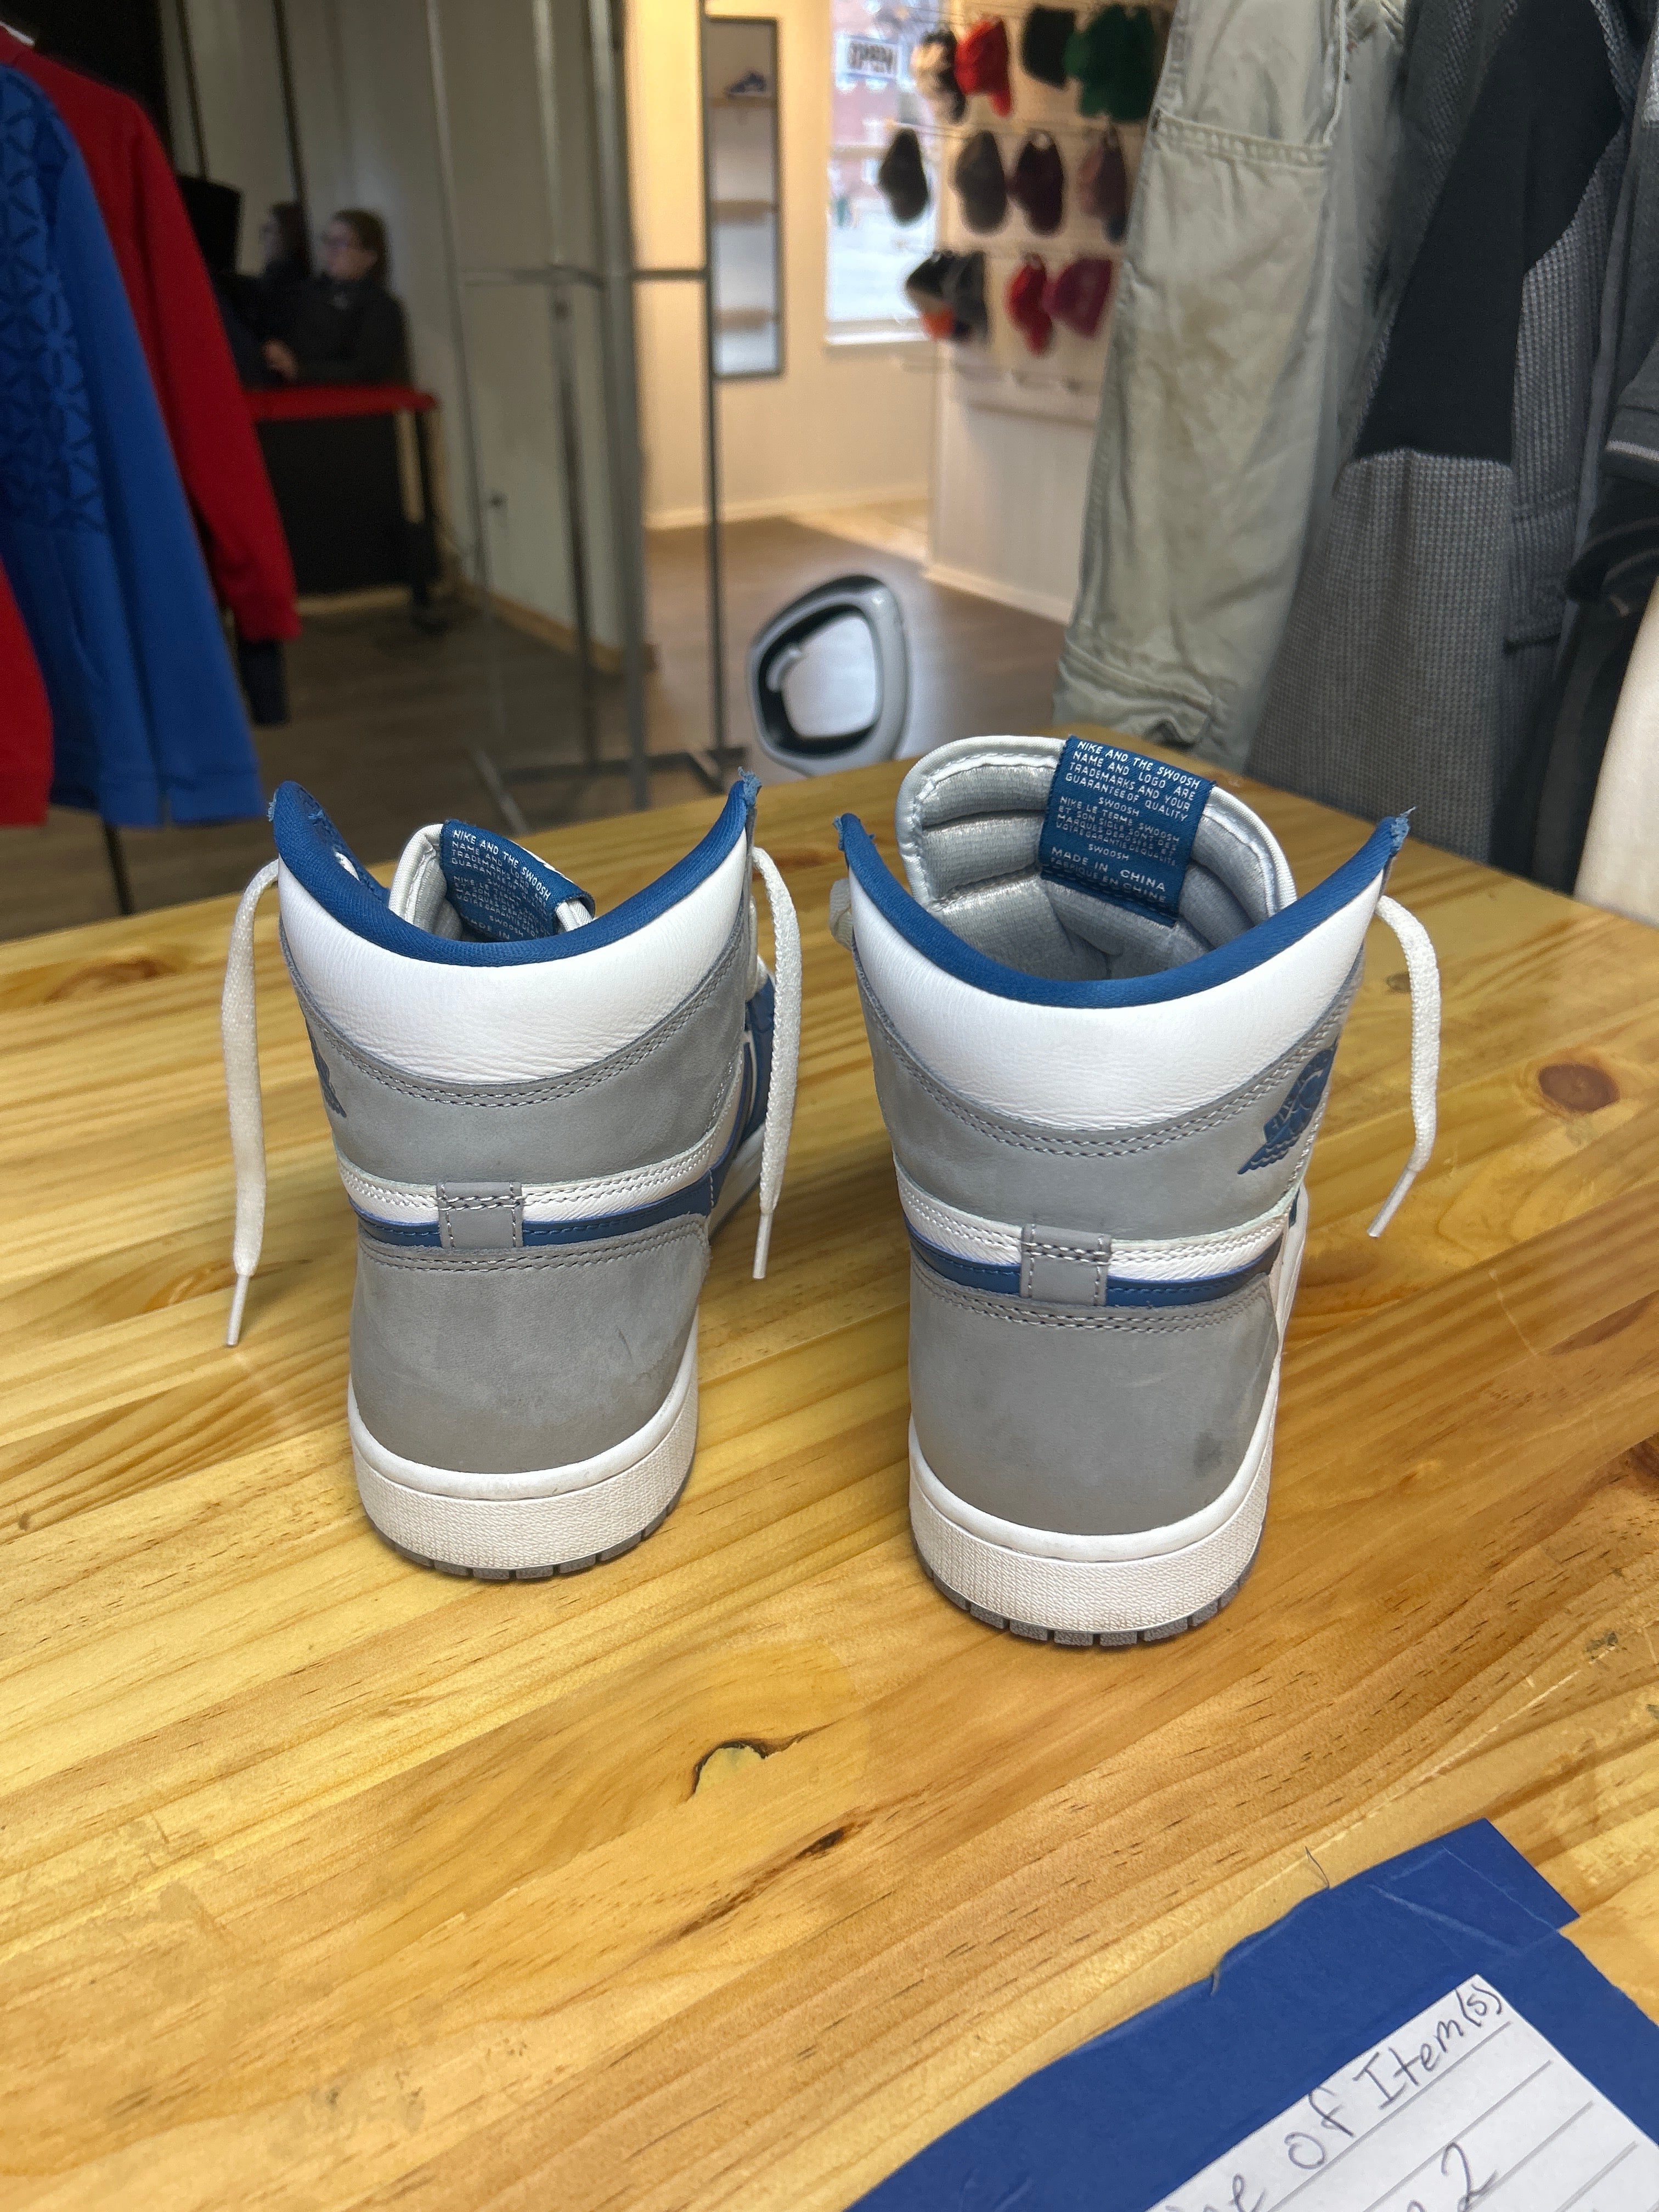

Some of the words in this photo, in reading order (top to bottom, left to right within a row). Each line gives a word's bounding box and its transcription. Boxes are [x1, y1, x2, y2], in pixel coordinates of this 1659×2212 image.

[1073, 751, 1104, 768] NAME
[1107, 762, 1130, 776] AND
[1138, 772, 1166, 788] LOGO
[1173, 786, 1195, 801] ARE
[1077, 741, 1103, 754] NIKE
[1105, 749, 1128, 762] AND
[1133, 758, 1153, 771] THE
[1156, 766, 1201, 790] SWOOSH
[1069, 762, 1136, 791] TRADEMARKS
[1137, 785, 1160, 799] AND
[1165, 794, 1190, 812] YOUR
[1058, 805, 1071, 814] ET
[1076, 811, 1096, 822] SON
[1060, 796, 1082, 809] NIKE
[1086, 804, 1098, 814] LE
[1138, 822, 1180, 842] SWOOSH
[1098, 797, 1139, 817] SWOOSH
[1144, 800, 1188, 822] QUALITY
[1057, 814, 1103, 833] MARQUES
[452, 840, 480, 855] NAME
[486, 853, 503, 867] AND
[452, 849, 510, 880] TRADEMARKS
[453, 830, 477, 845] NIKE
[479, 840, 499, 855] AND
[503, 851, 519, 869] THE
[522, 867, 551, 901] SWOOSH
[1088, 844, 1129, 861] SWOOSH
[1052, 847, 1088, 865] MADE
[1094, 862, 1108, 872] IN
[1120, 870, 1165, 892] CHINA
[1103, 876, 1119, 885] EN
[1123, 883, 1166, 902] CHINE
[1352, 1984, 1502, 2109] Item(s)
